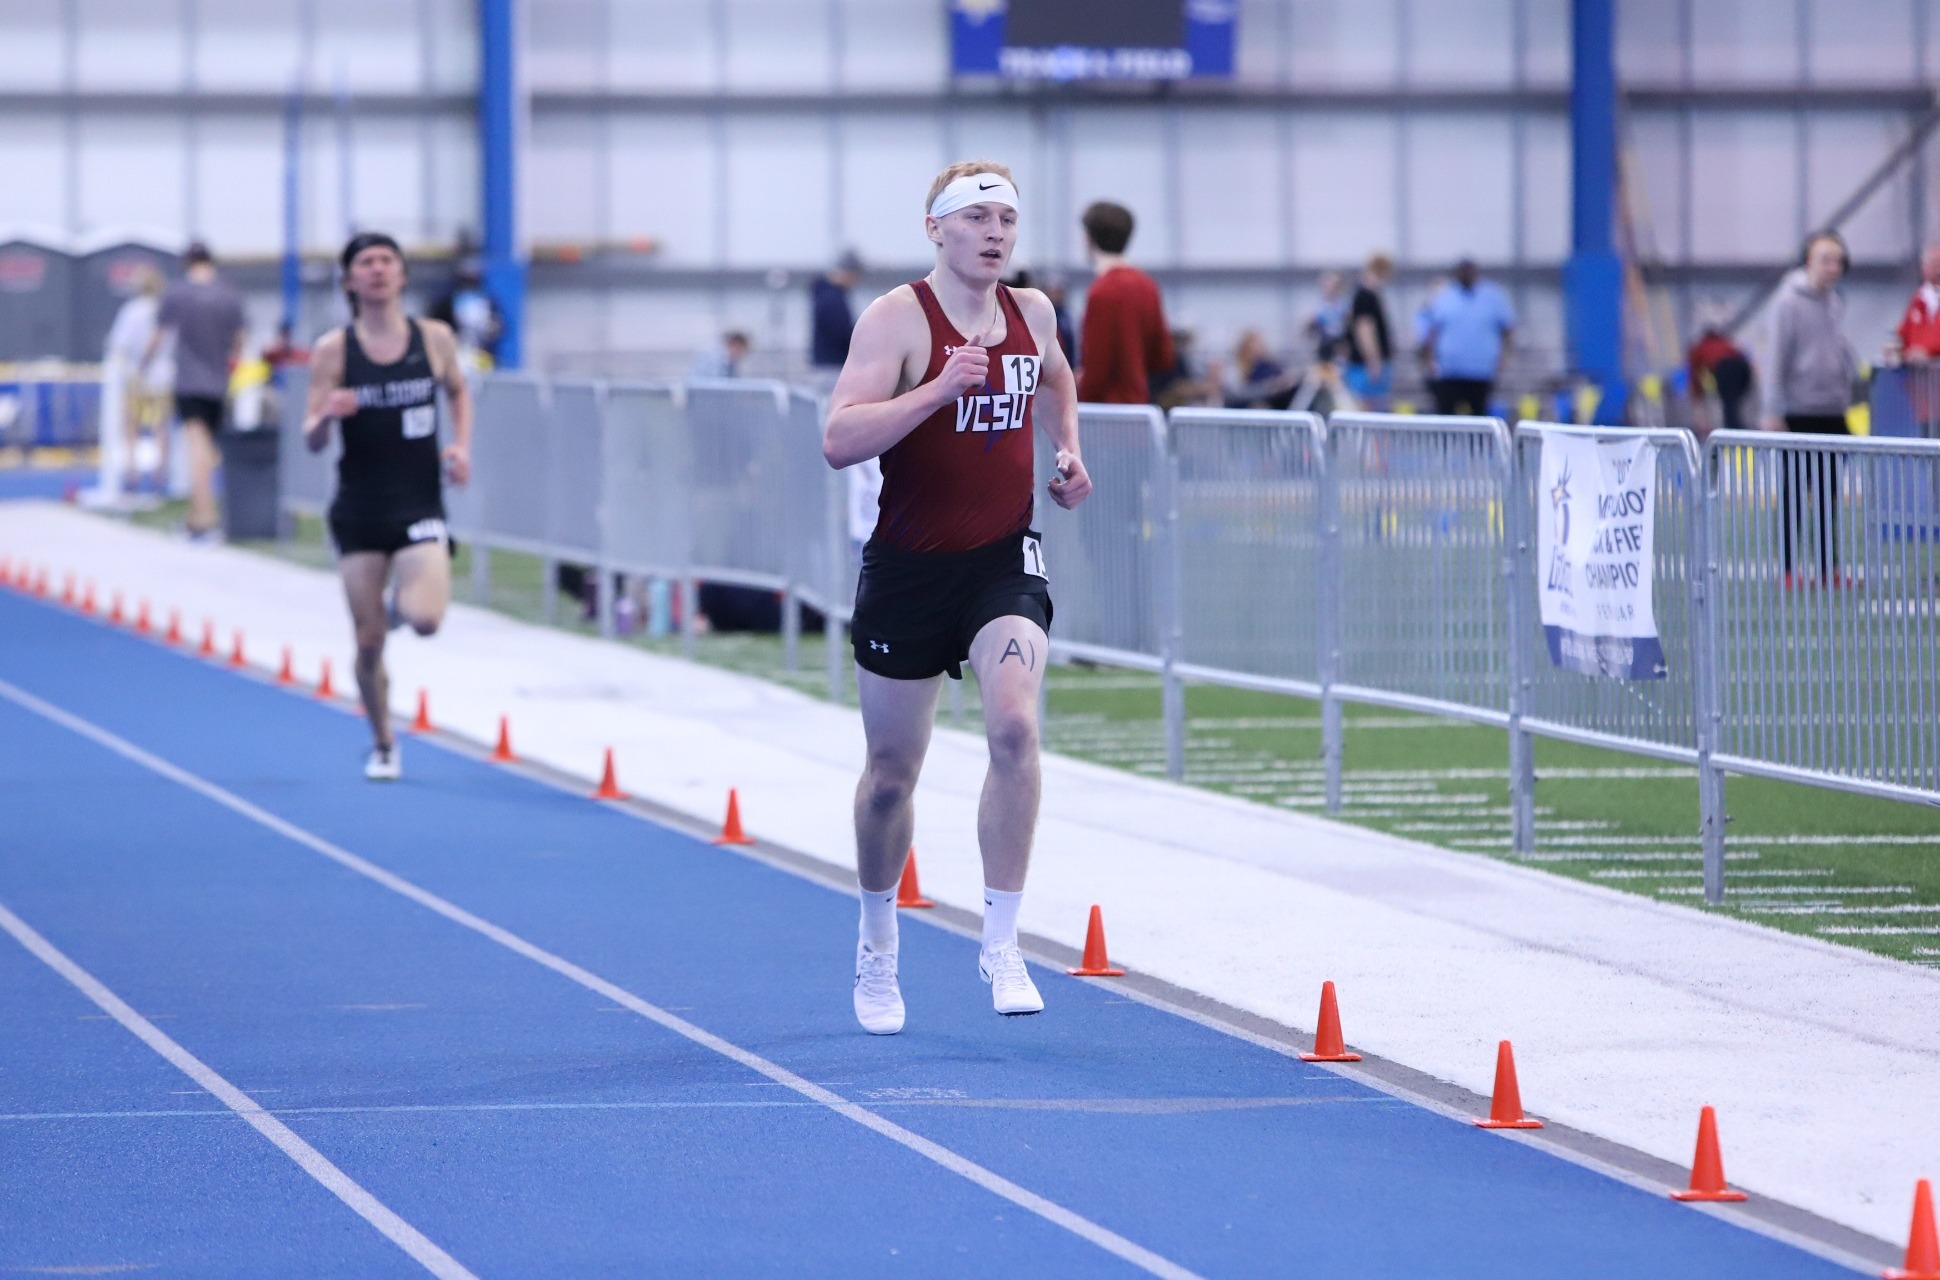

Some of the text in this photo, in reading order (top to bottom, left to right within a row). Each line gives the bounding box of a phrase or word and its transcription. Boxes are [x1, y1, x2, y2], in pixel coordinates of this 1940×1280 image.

[1010, 356, 1034, 393] 13
[955, 393, 1027, 432] VCSU
[1613, 525, 1643, 554] FIE
